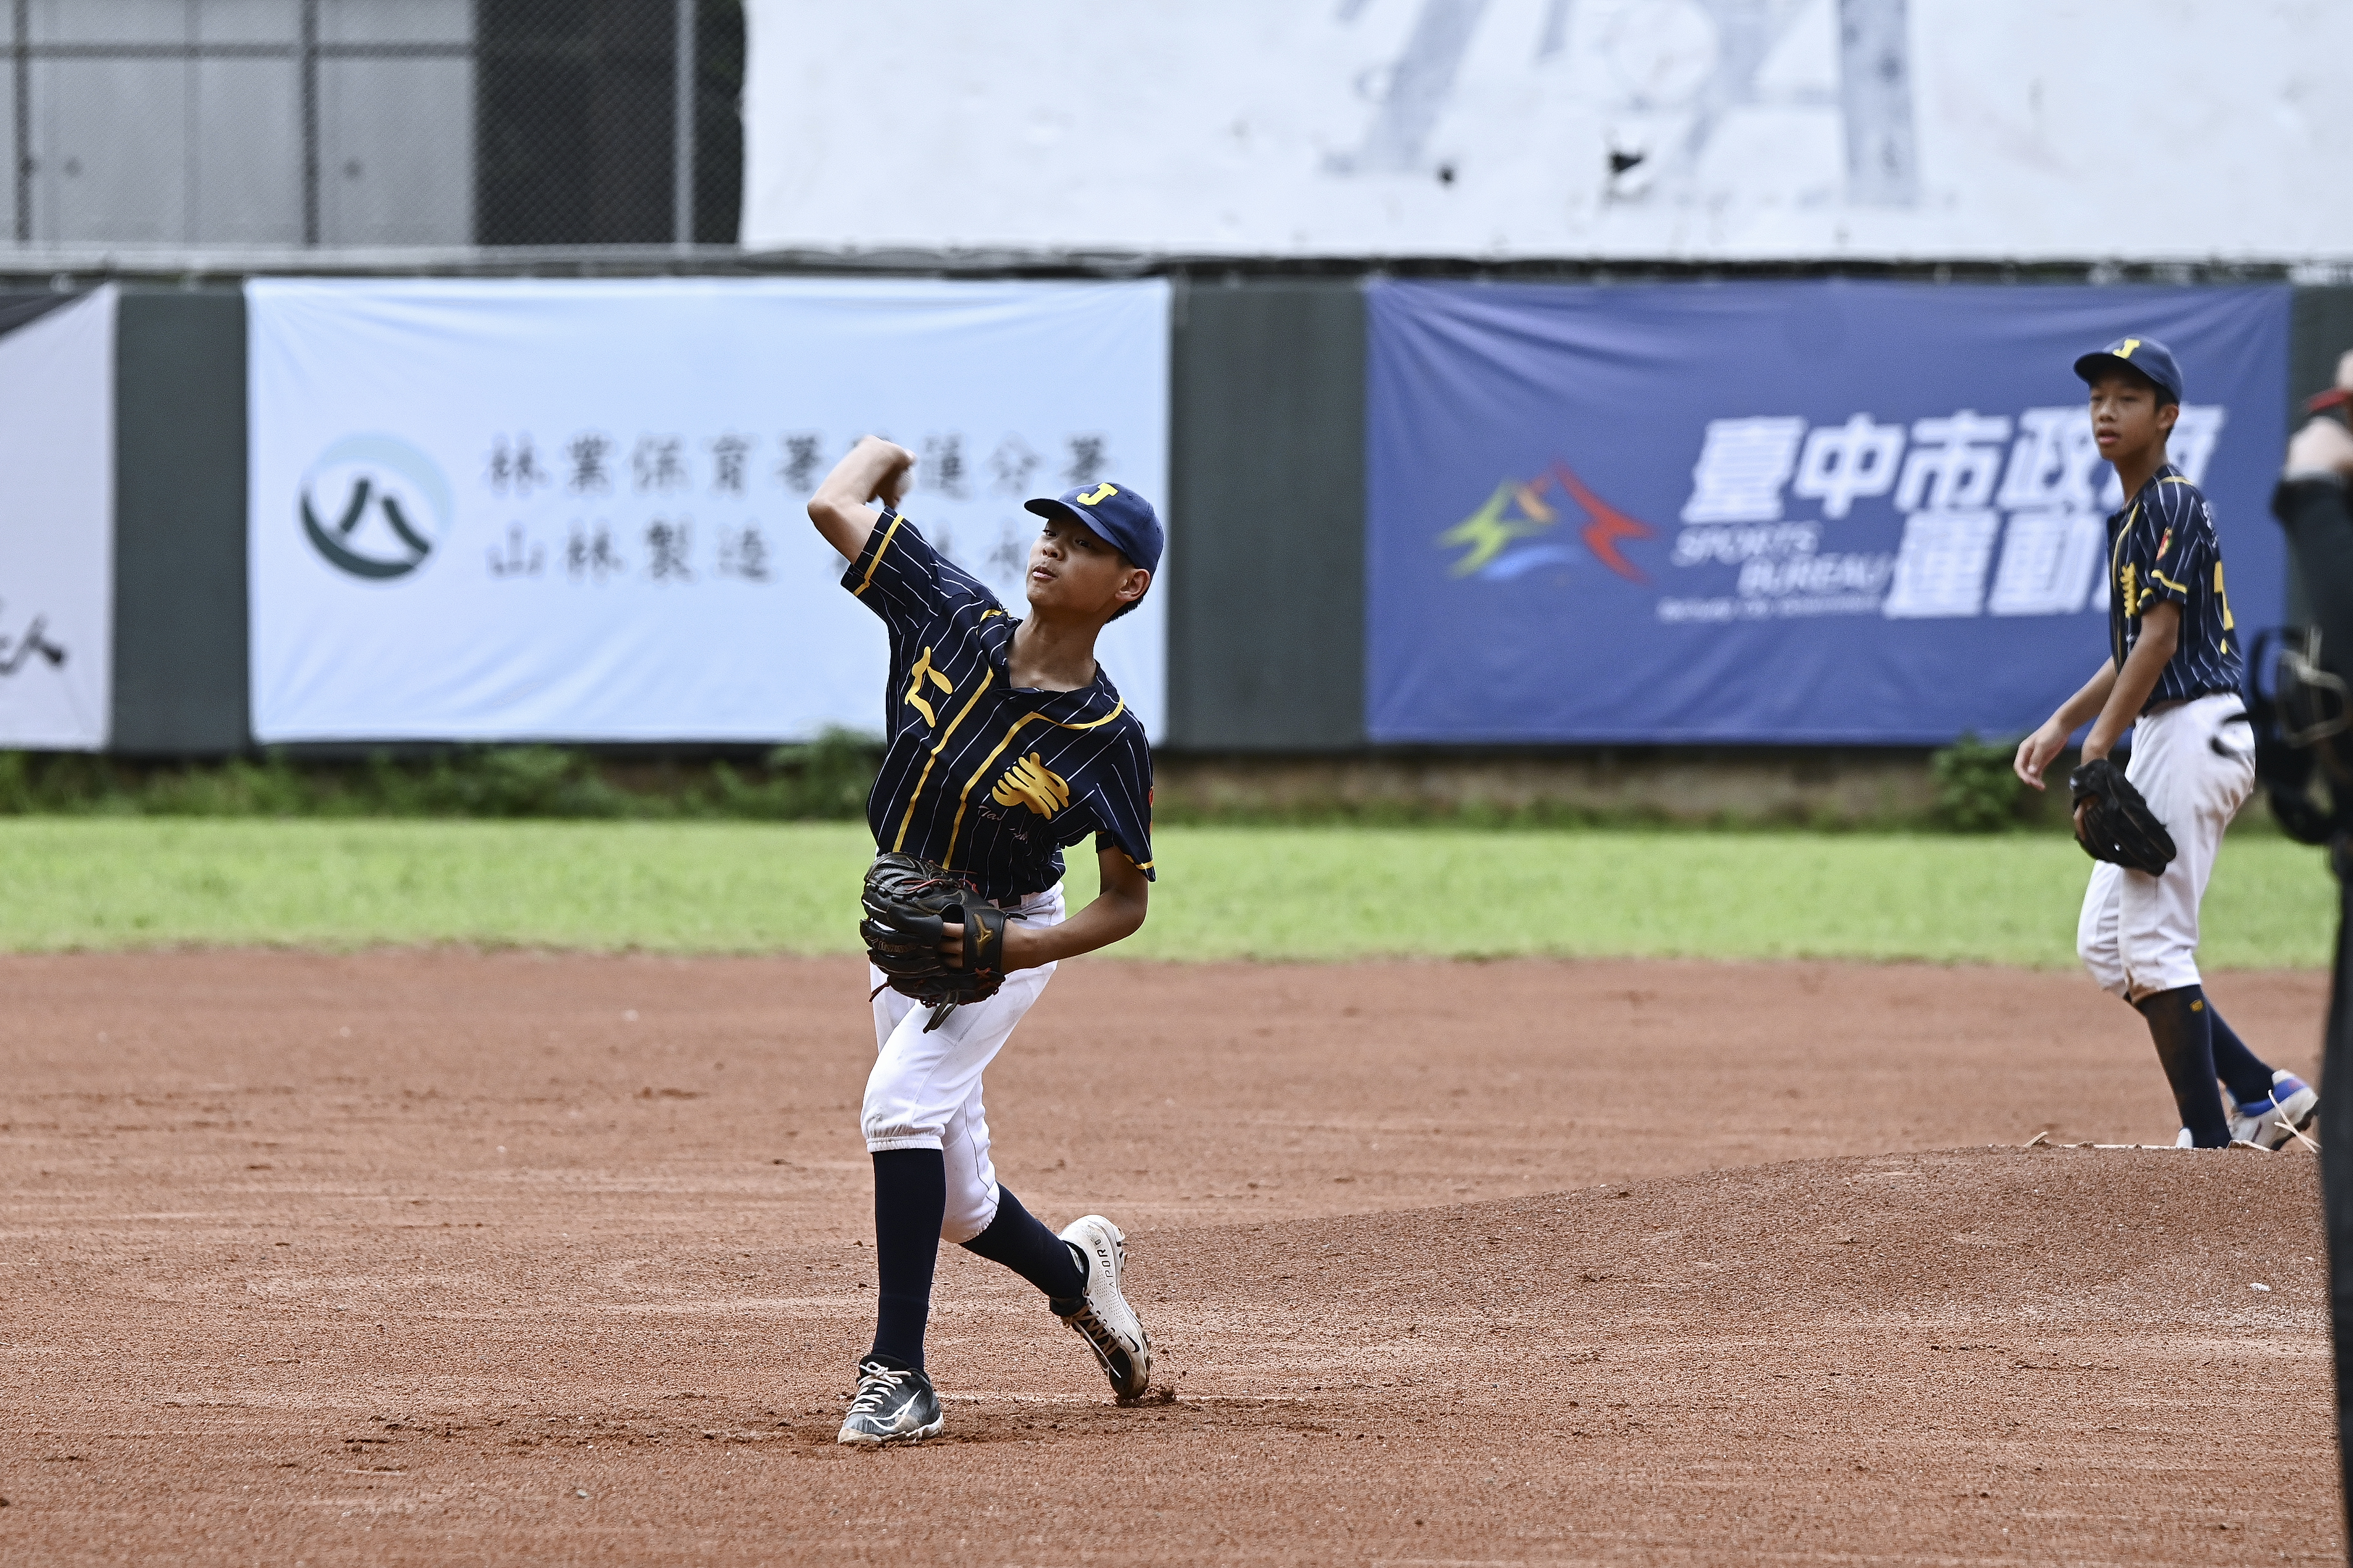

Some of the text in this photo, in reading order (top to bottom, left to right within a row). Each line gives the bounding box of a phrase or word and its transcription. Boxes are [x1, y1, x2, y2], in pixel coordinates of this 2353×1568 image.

[2113, 339, 2140, 359] J
[1076, 482, 1119, 506] J
[1884, 508, 2113, 618] 運動
[1096, 1248, 1117, 1298] VAPOR
